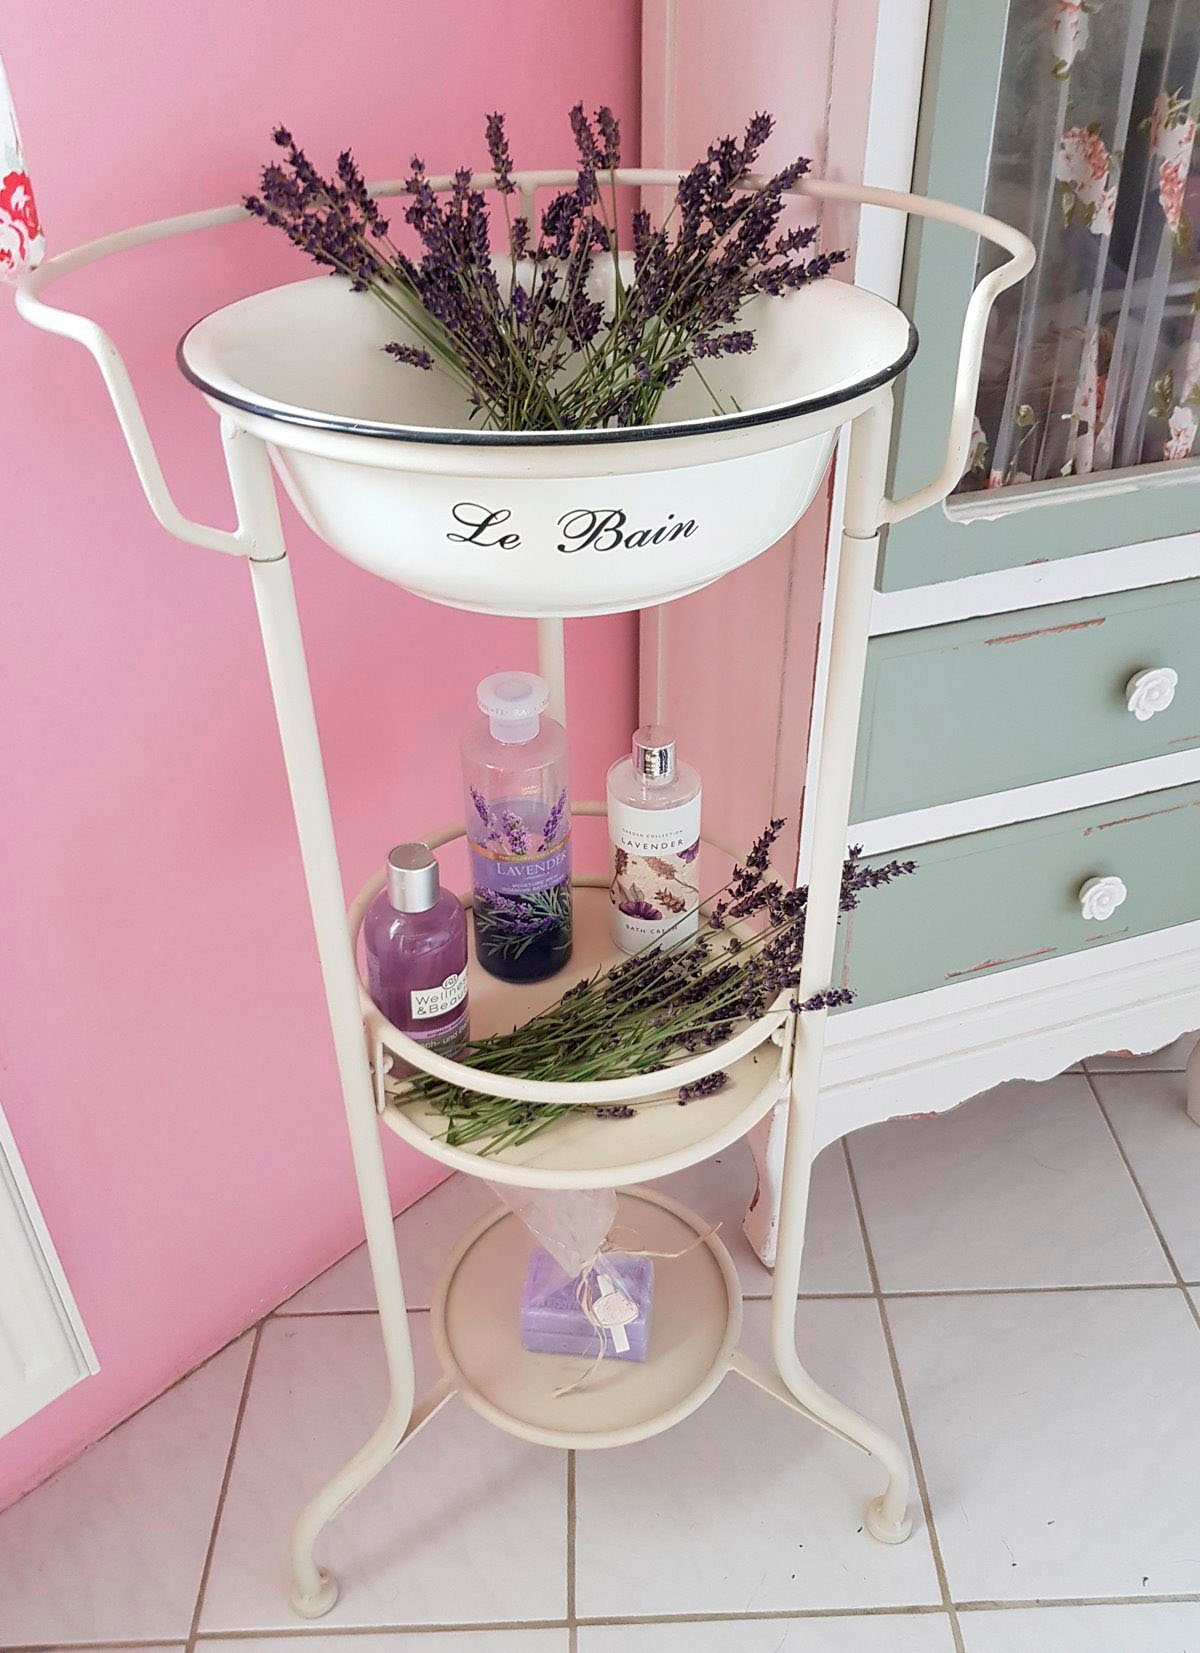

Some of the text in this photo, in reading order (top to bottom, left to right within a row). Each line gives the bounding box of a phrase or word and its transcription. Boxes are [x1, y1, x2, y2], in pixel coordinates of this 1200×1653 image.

[447, 502, 699, 553] Le Bain
[621, 837, 684, 850] LAVENDER
[626, 923, 678, 935] BATH CREM
